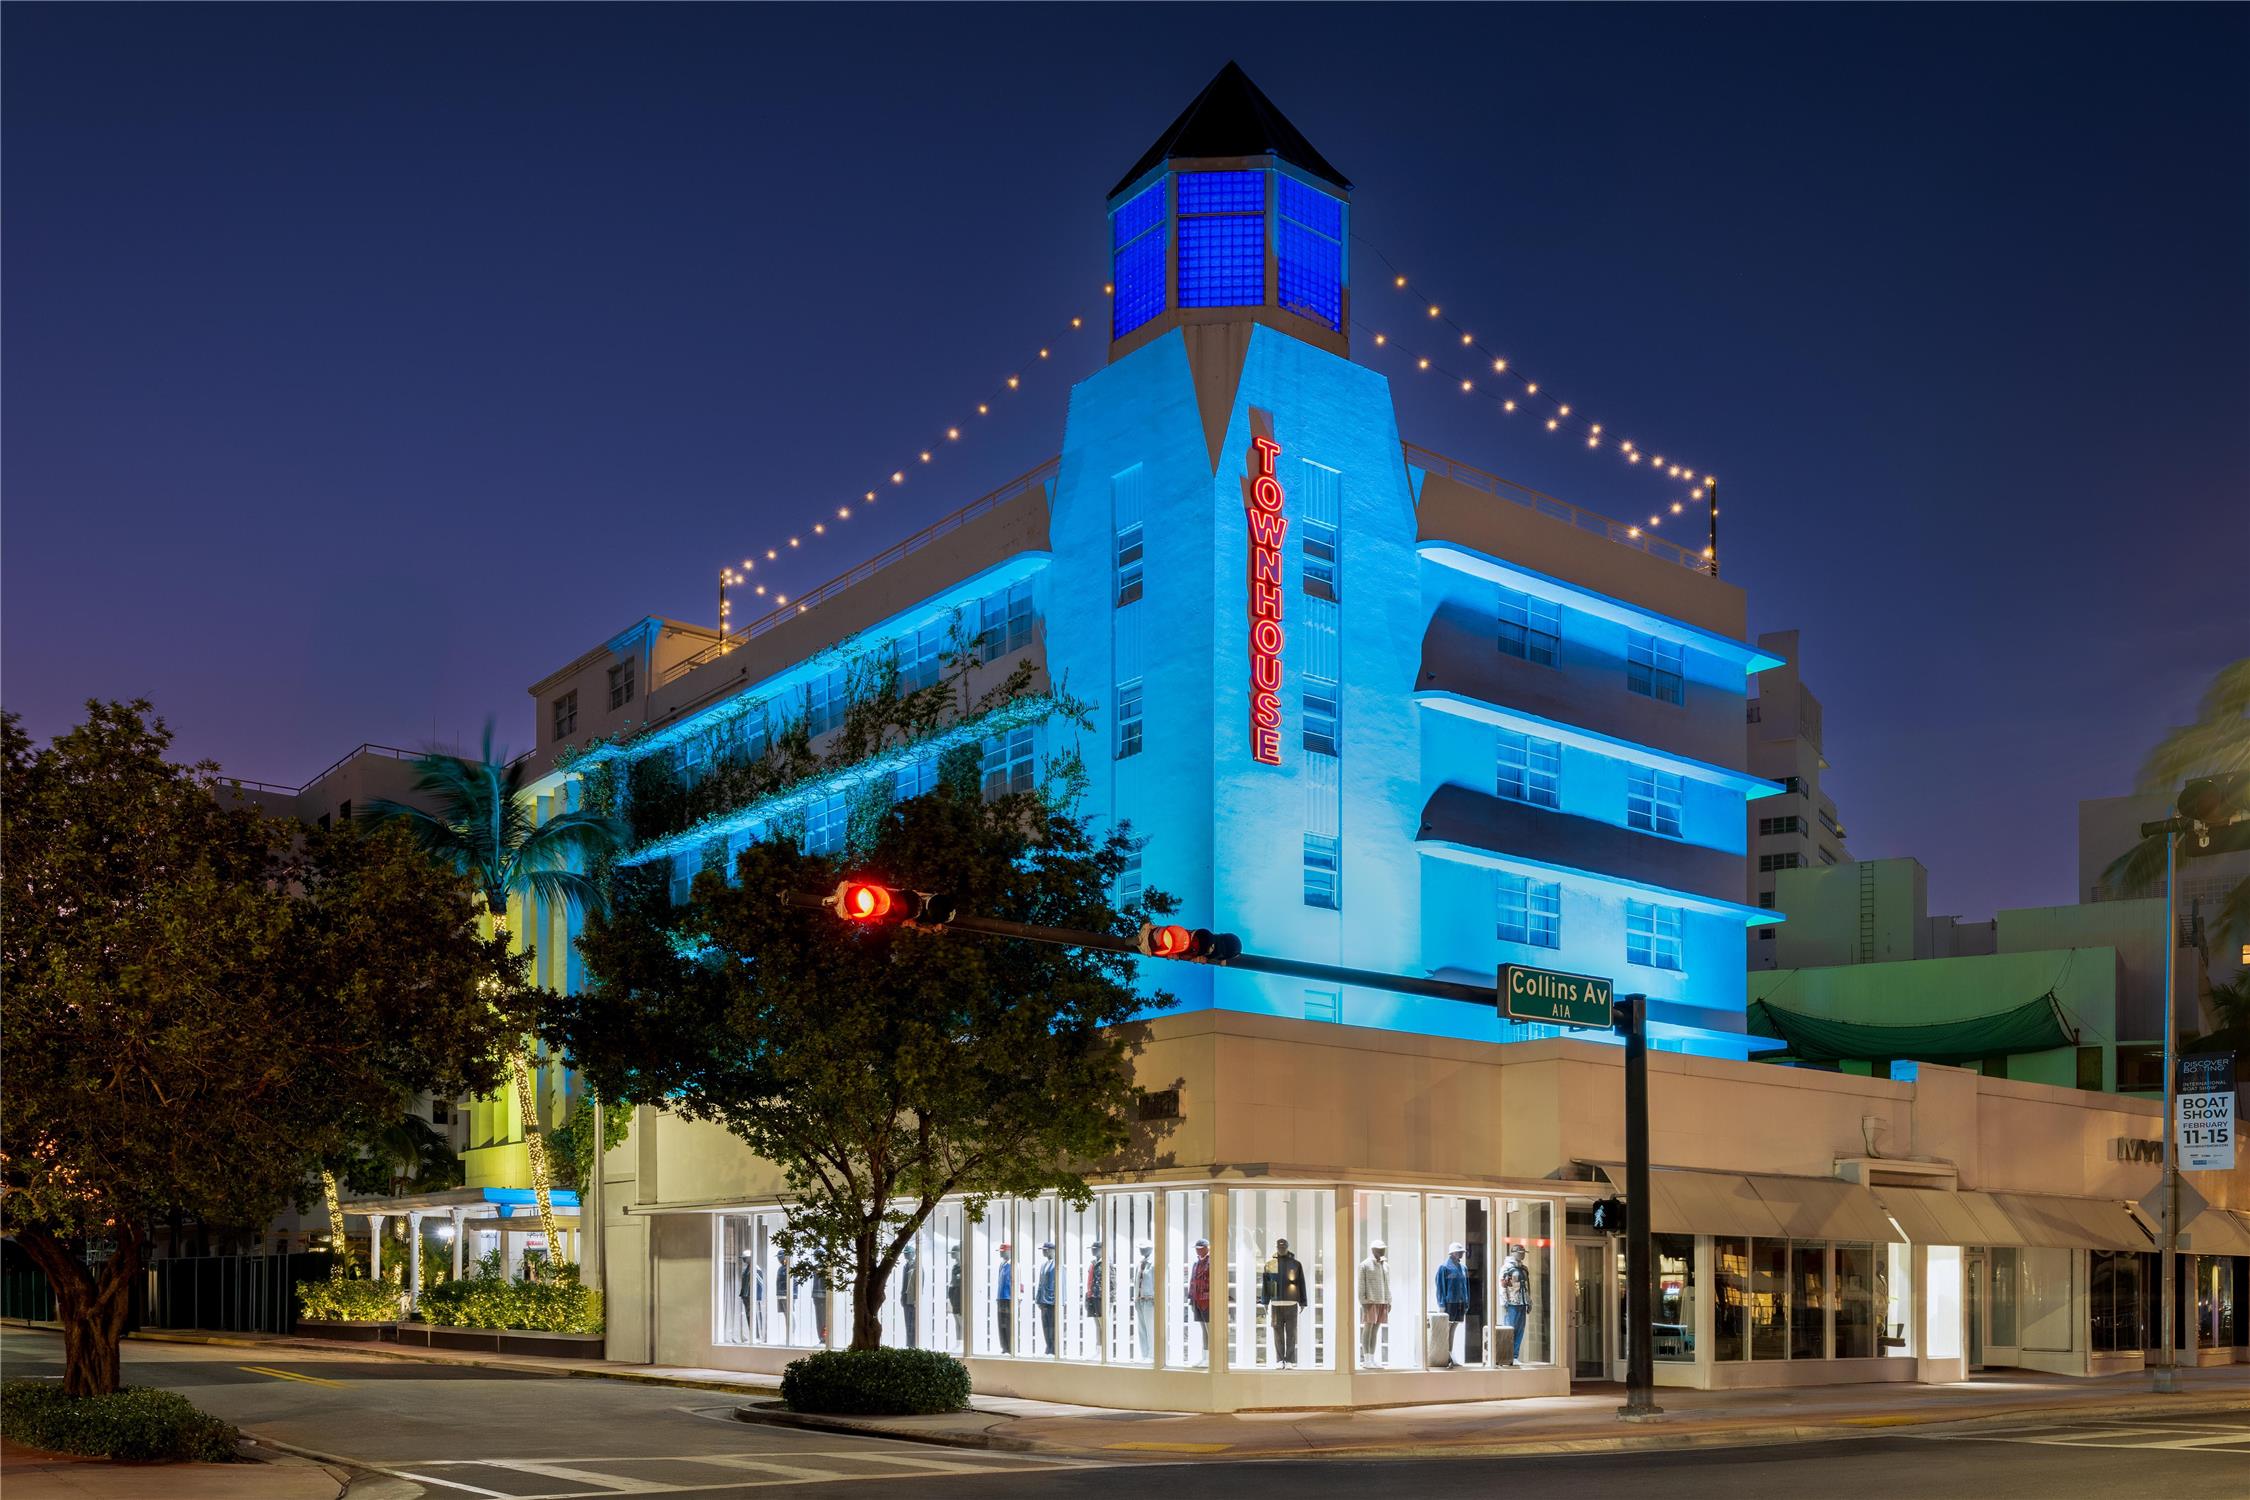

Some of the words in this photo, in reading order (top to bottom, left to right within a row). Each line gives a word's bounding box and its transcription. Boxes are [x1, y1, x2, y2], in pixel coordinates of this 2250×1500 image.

[1248, 436, 1289, 766] TOWNHOUSE
[1512, 970, 1578, 1002] Collins
[1583, 981, 1608, 1005] Av
[1552, 1003, 1571, 1019] A1A
[2183, 1058, 2229, 1068] DISCOVER
[2183, 1096, 2229, 1109] BOAT
[2183, 1108, 2228, 1120] SHOW
[2183, 1121, 2228, 1129] FEBRUARY
[2183, 1129, 2229, 1144] 11-15
